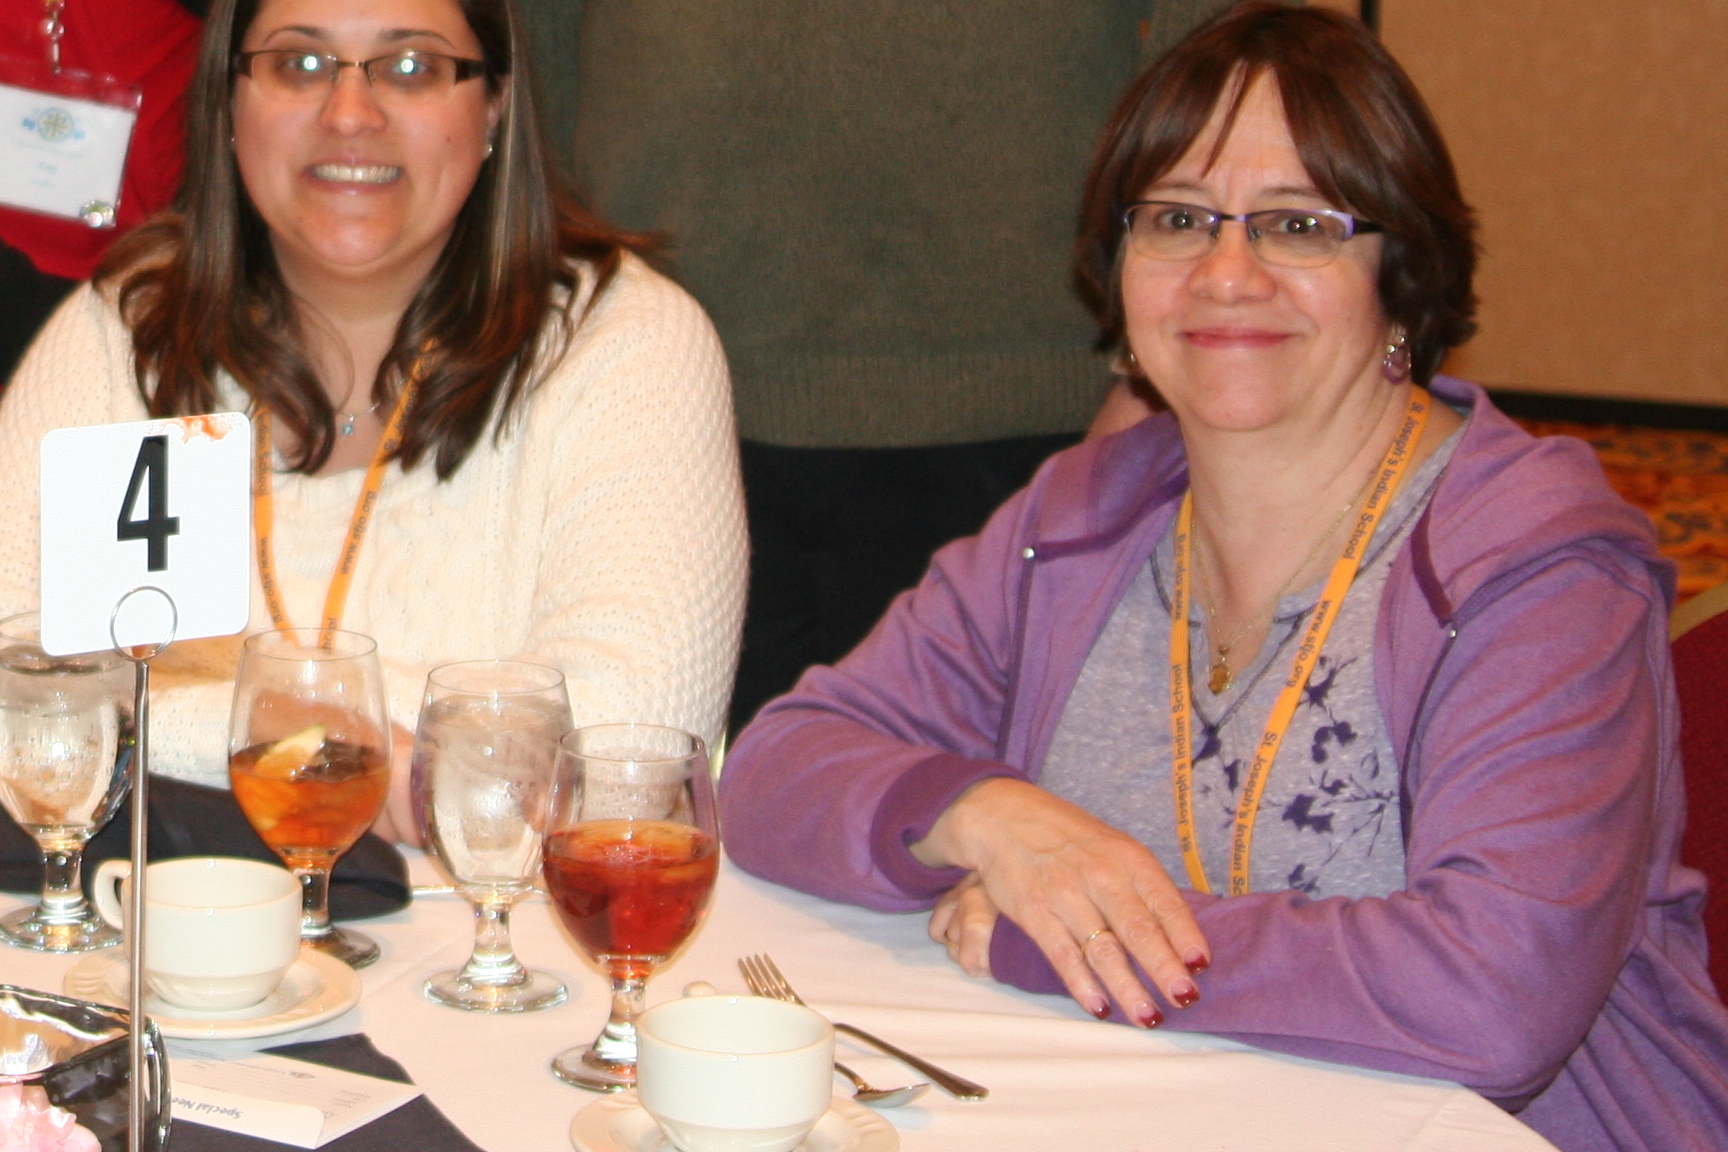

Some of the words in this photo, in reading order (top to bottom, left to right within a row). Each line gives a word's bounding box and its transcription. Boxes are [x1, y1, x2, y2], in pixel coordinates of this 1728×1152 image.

[1387, 416, 1422, 467] Joseph's
[117, 435, 180, 573] 4
[1367, 469, 1398, 510] Indian
[340, 490, 377, 575] www.stjo.org
[1343, 512, 1376, 560] School
[1285, 599, 1333, 689] www.stjo.org
[1172, 663, 1183, 713] School
[1174, 715, 1185, 761] Indian
[1261, 730, 1278, 749] St.
[1177, 762, 1189, 830] Joseph's
[1236, 753, 1269, 820] Joseph's
[1232, 822, 1248, 872] Indian
[195, 1102, 244, 1120] Special
